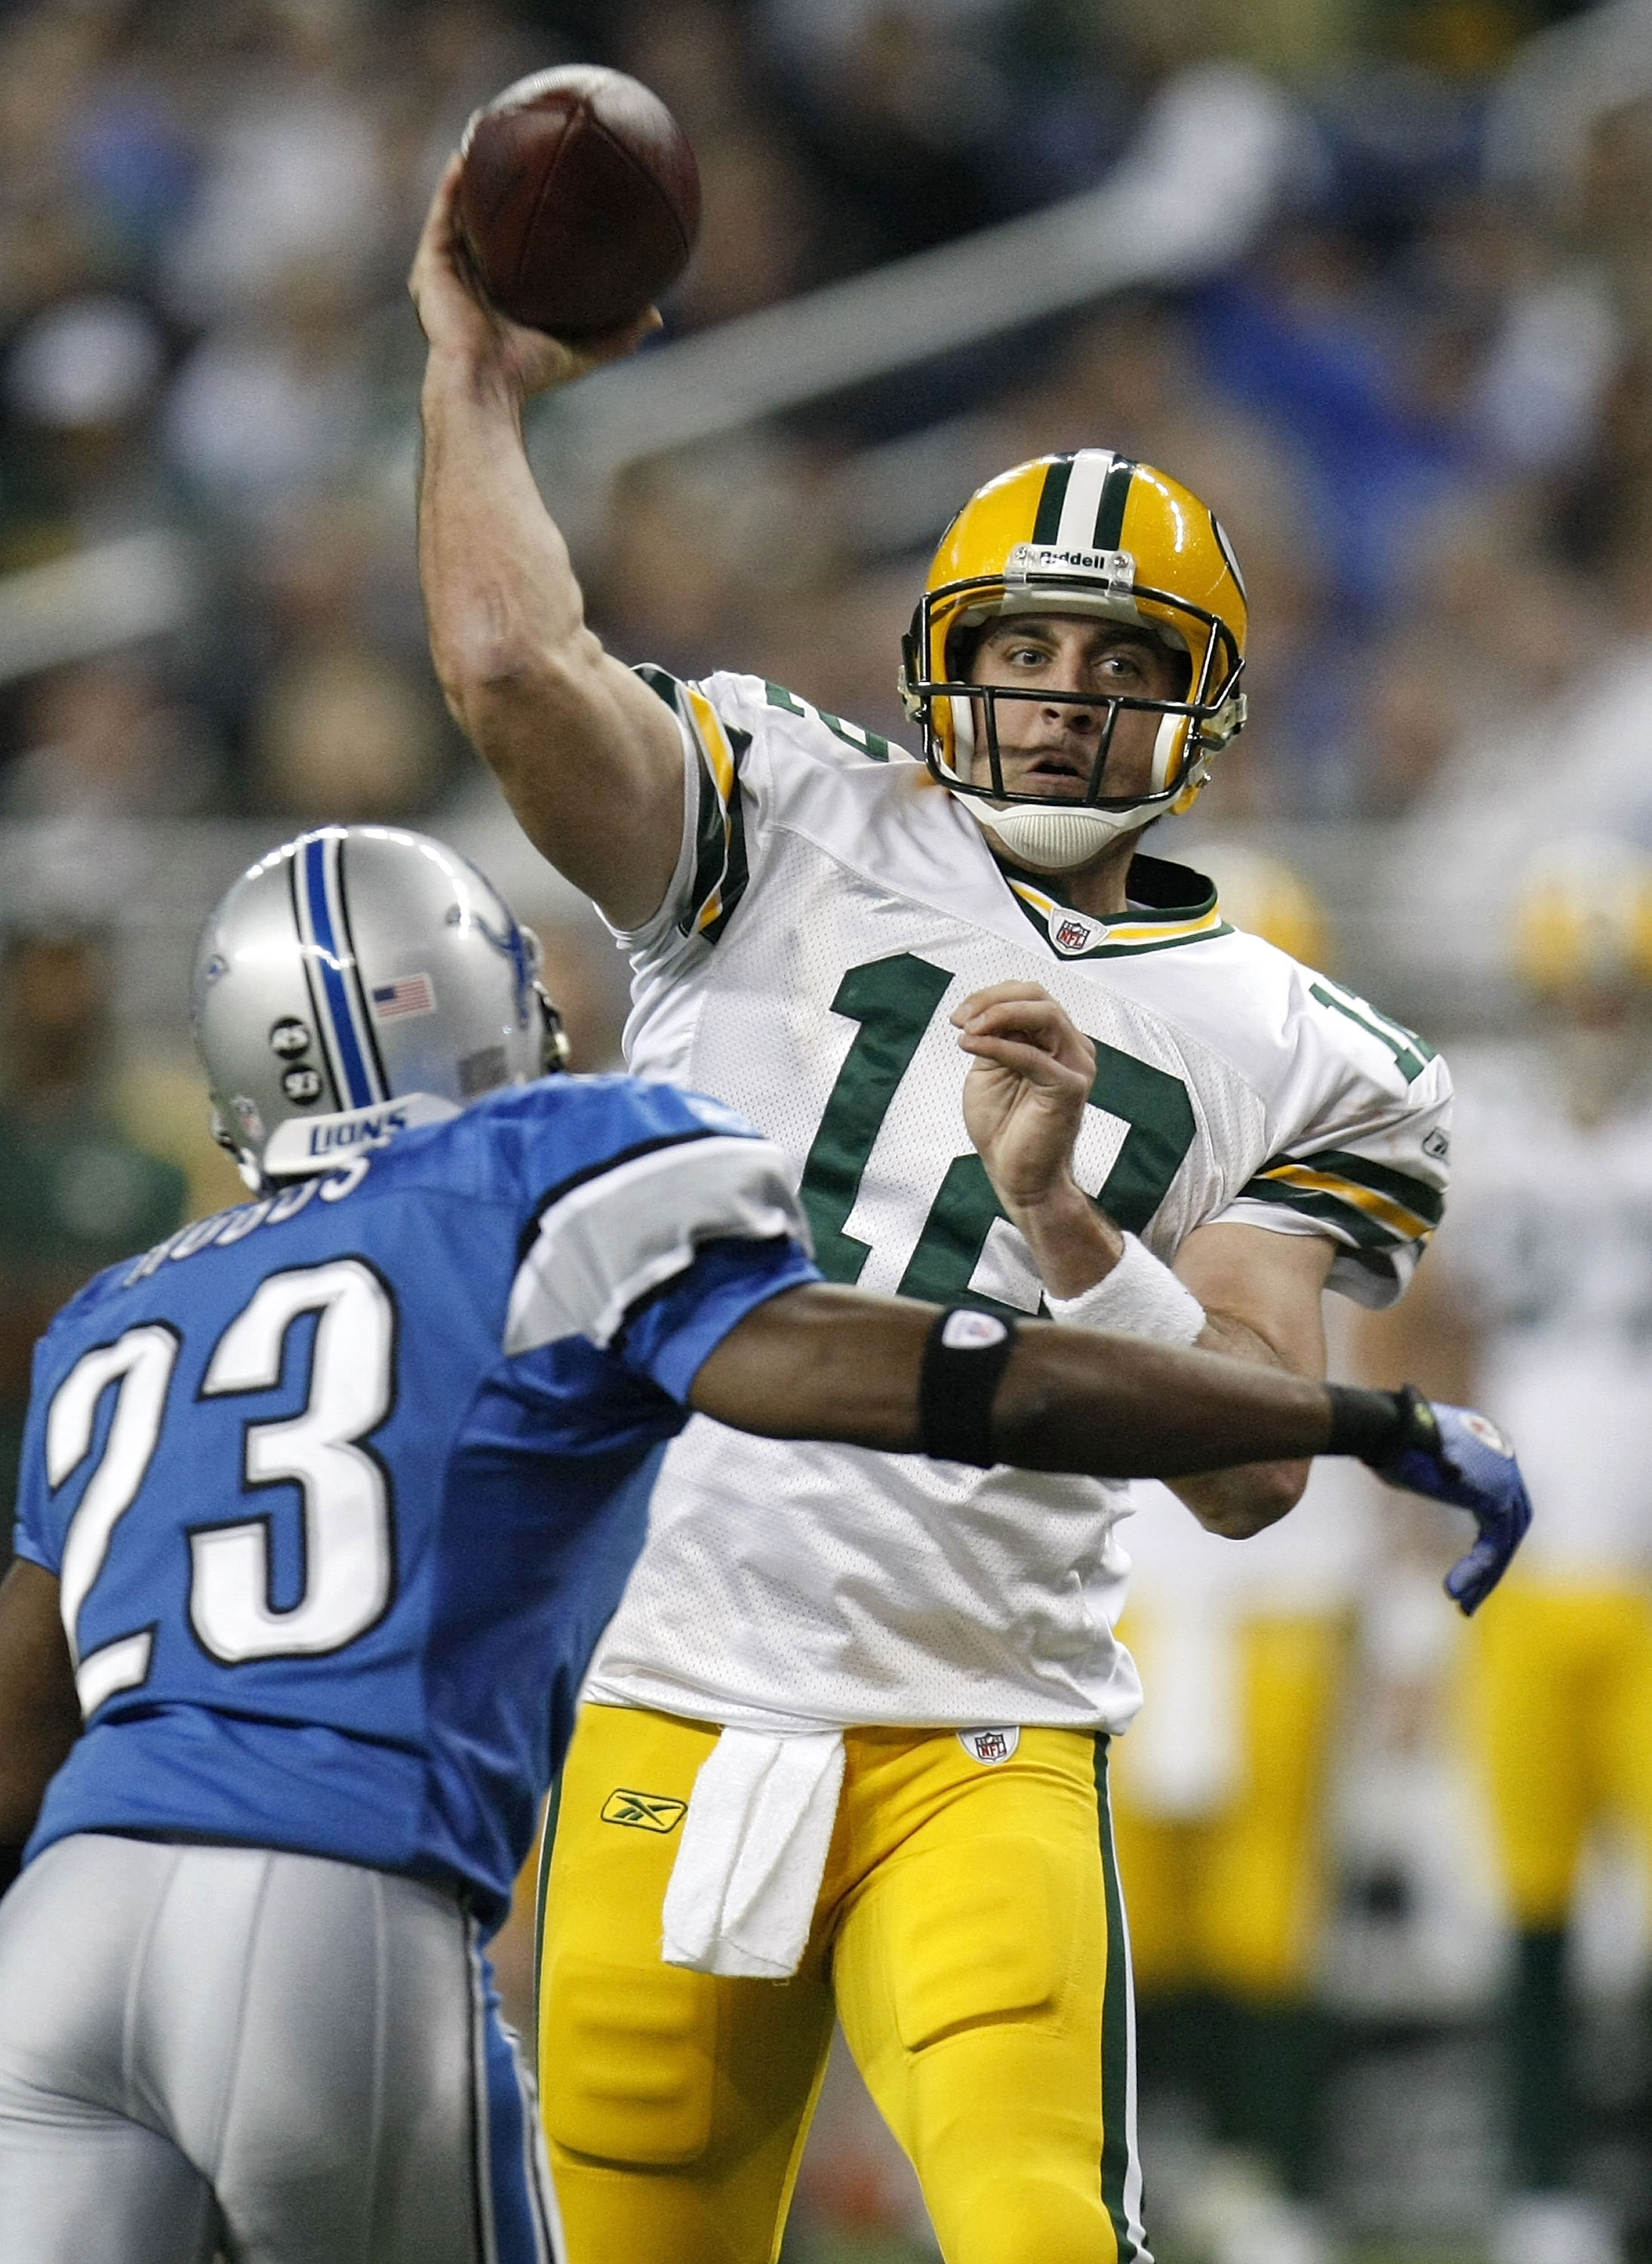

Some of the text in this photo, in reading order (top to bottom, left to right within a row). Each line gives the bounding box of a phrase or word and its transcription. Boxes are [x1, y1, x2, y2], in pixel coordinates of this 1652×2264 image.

[1059, 929, 1084, 947] NFL
[310, 1108, 408, 1155] LIONS
[46, 1253, 400, 1724] 23
[982, 1742, 1007, 1758] NFL
